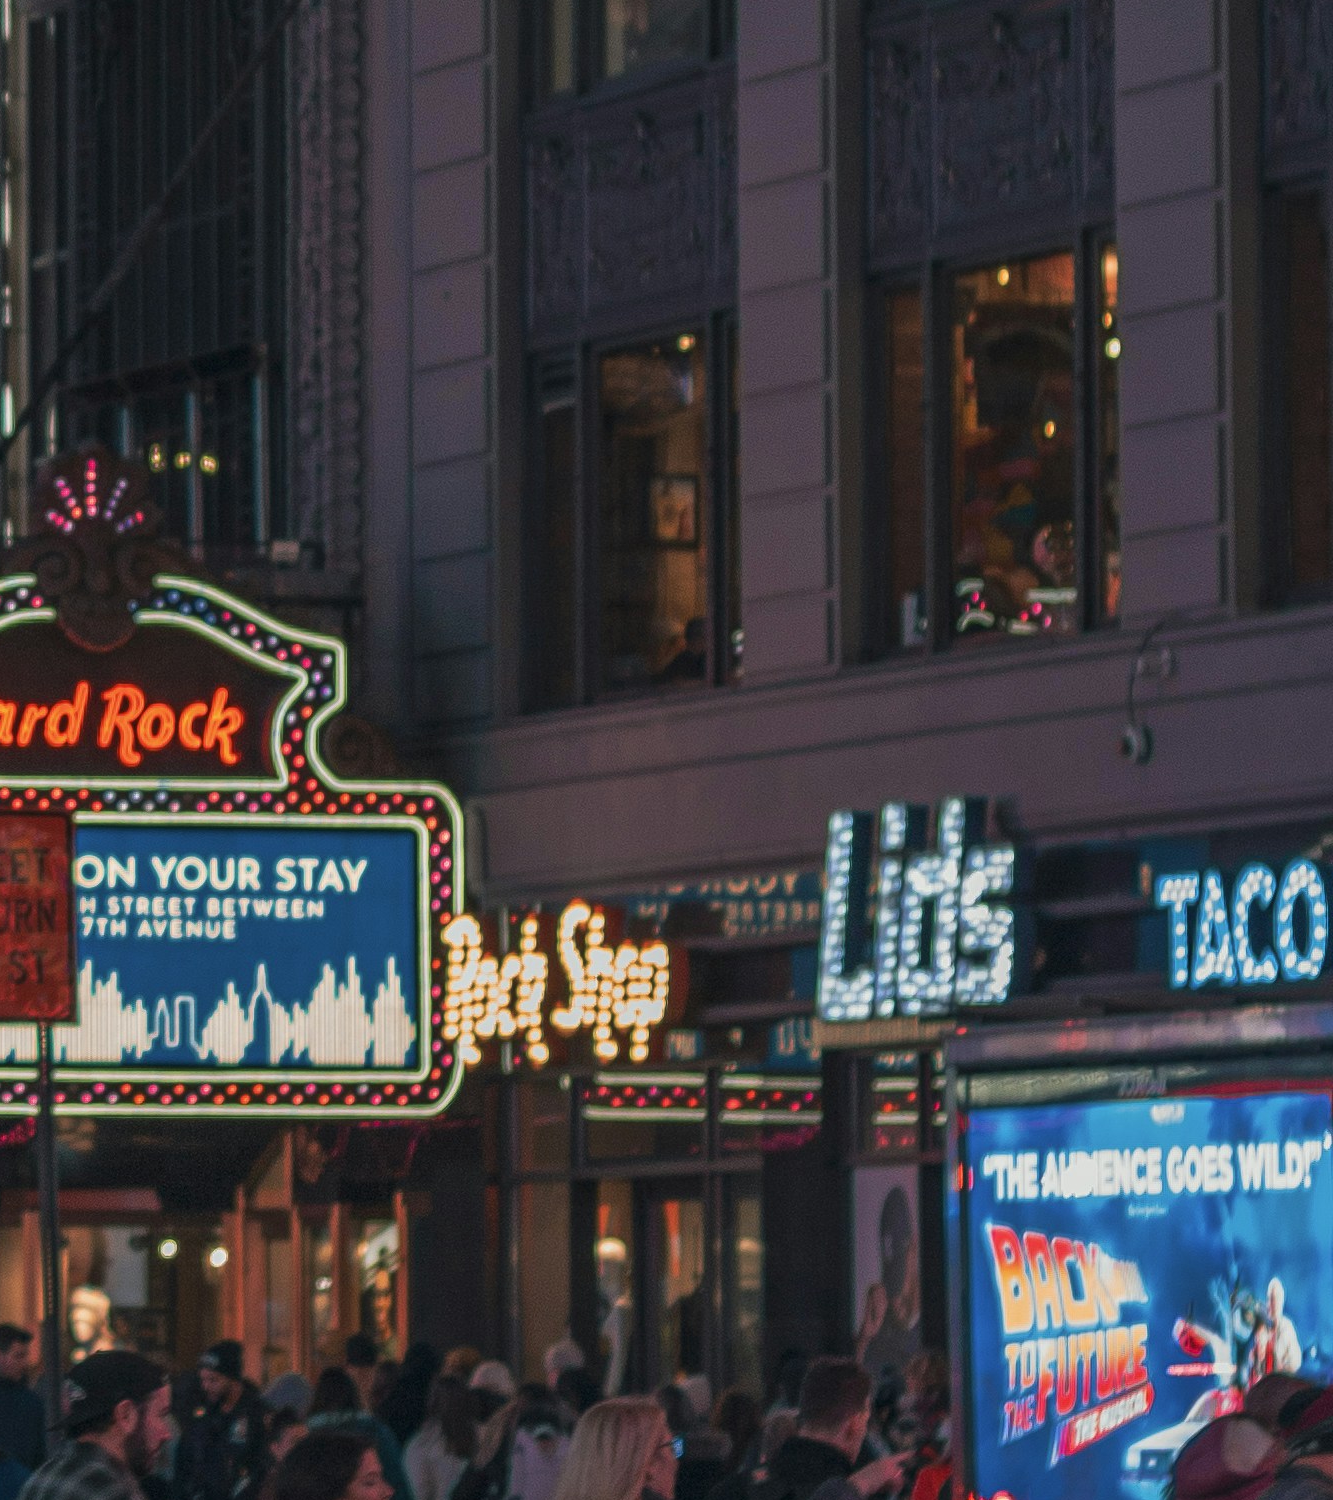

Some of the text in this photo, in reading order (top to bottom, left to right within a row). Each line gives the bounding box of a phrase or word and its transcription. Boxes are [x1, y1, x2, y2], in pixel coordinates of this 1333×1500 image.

[96, 681, 245, 768] Rock
[73, 854, 368, 893] ON YOUR STAY
[107, 895, 196, 917] STREET
[206, 897, 325, 919] BETWEEN
[81, 917, 237, 939] 7TH AVENUE
[1156, 857, 1330, 989] TACO
[7, 948, 46, 985] ST
[550, 899, 671, 1062] Shop
[1041, 1147, 1163, 1198] AUDIENCE
[1166, 1143, 1234, 1195] GOES
[986, 1225, 1123, 1334] BACK
[1004, 1323, 1149, 1425] TO FUTURE
